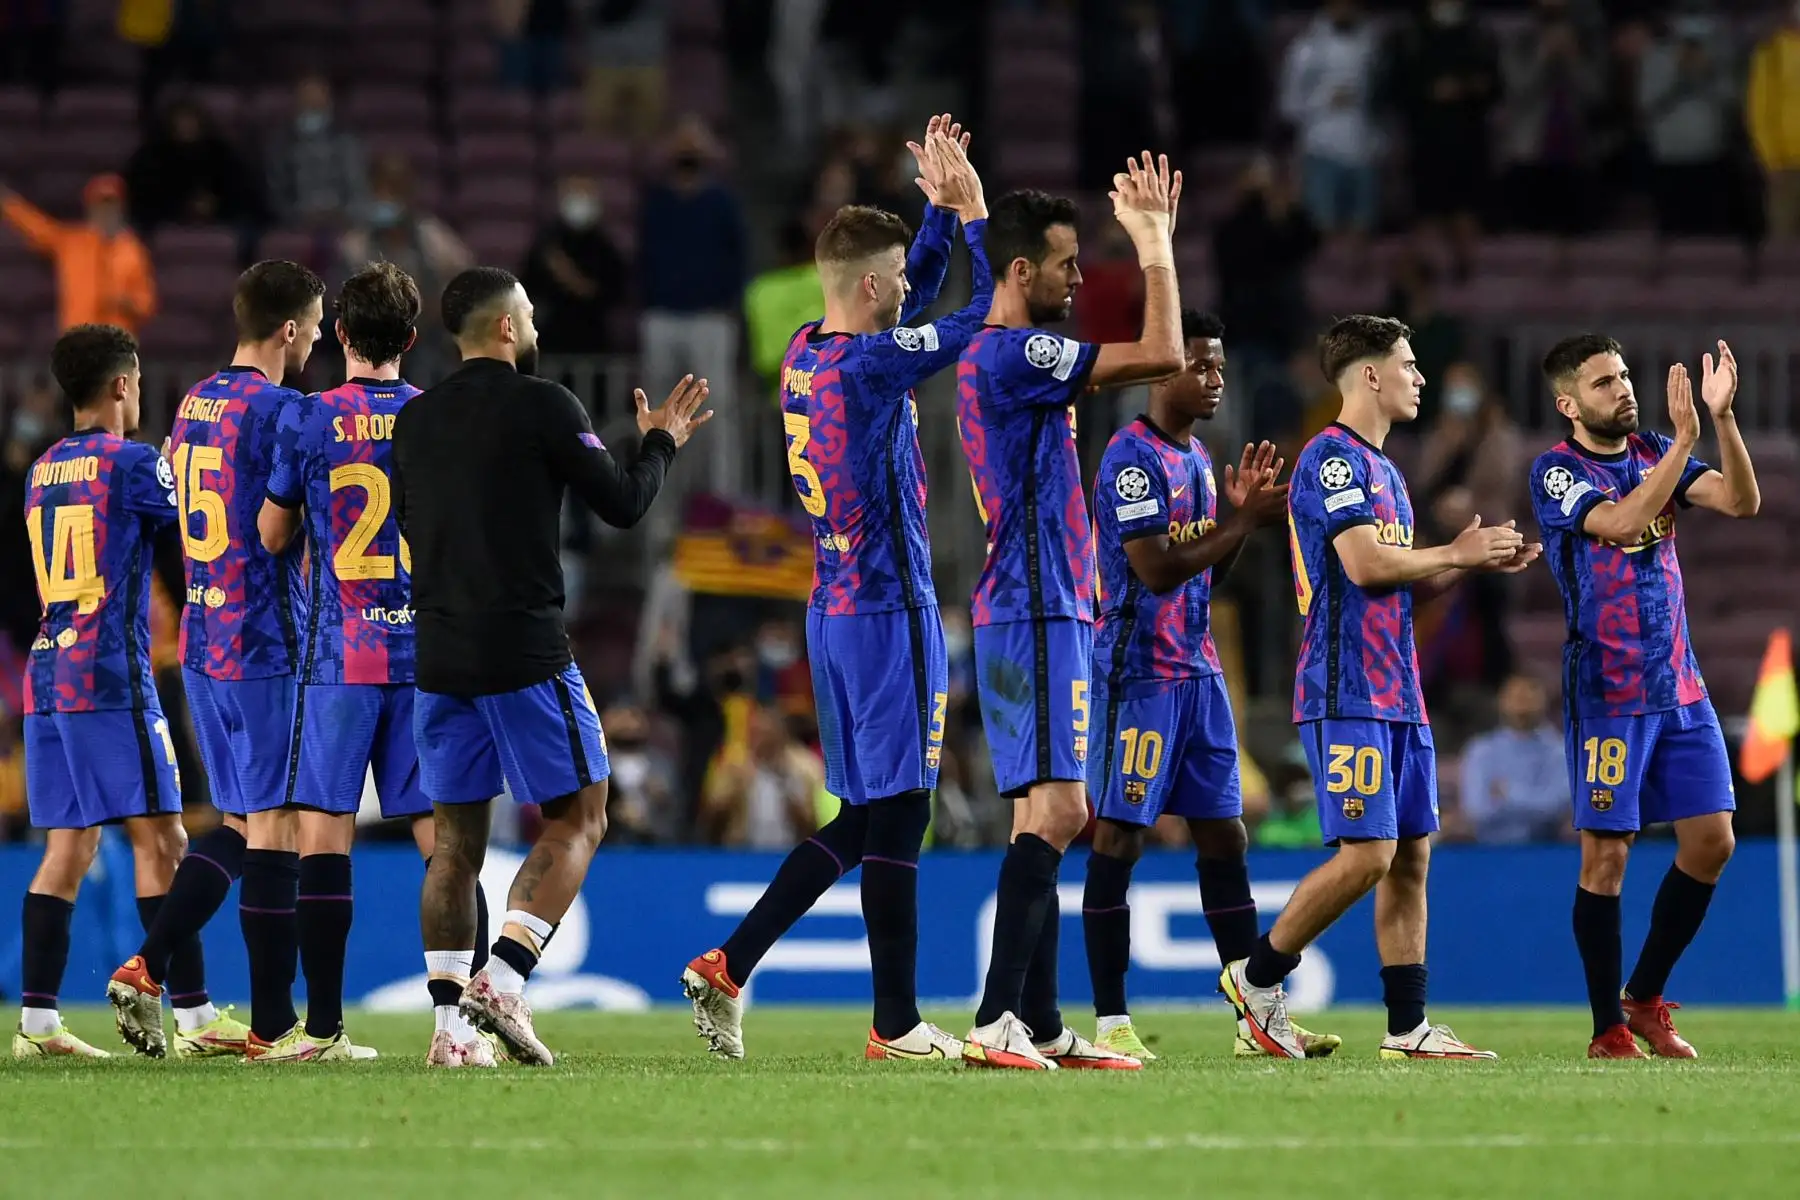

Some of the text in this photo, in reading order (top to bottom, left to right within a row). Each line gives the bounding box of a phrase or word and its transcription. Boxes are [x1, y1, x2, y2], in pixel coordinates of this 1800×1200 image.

[783, 365, 817, 398] PIQUÉ
[178, 394, 229, 422] LENGLET
[784, 412, 827, 517] 3
[173, 443, 230, 563] 15
[26, 505, 105, 616] 14
[929, 692, 947, 742] 3
[1072, 680, 1089, 732] 5
[1120, 727, 1163, 779] 10
[1326, 744, 1382, 795] 30
[1584, 736, 1628, 786] 18
